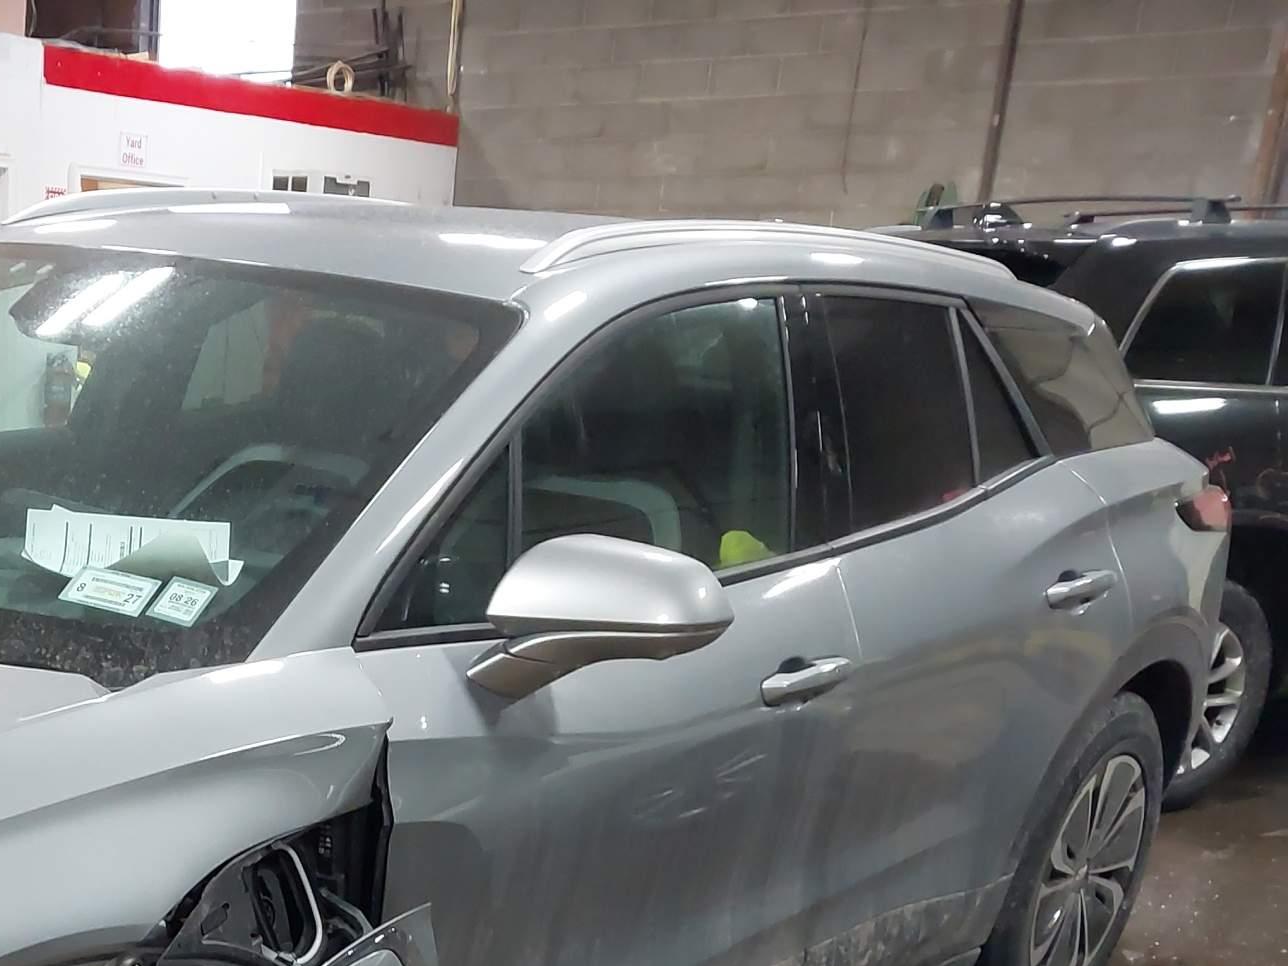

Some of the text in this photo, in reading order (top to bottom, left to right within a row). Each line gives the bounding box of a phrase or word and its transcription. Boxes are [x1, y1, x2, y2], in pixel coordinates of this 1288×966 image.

[126, 136, 142, 149] Yard
[122, 152, 144, 166] Office
[123, 594, 142, 606] 27
[169, 592, 199, 606] 08 26
